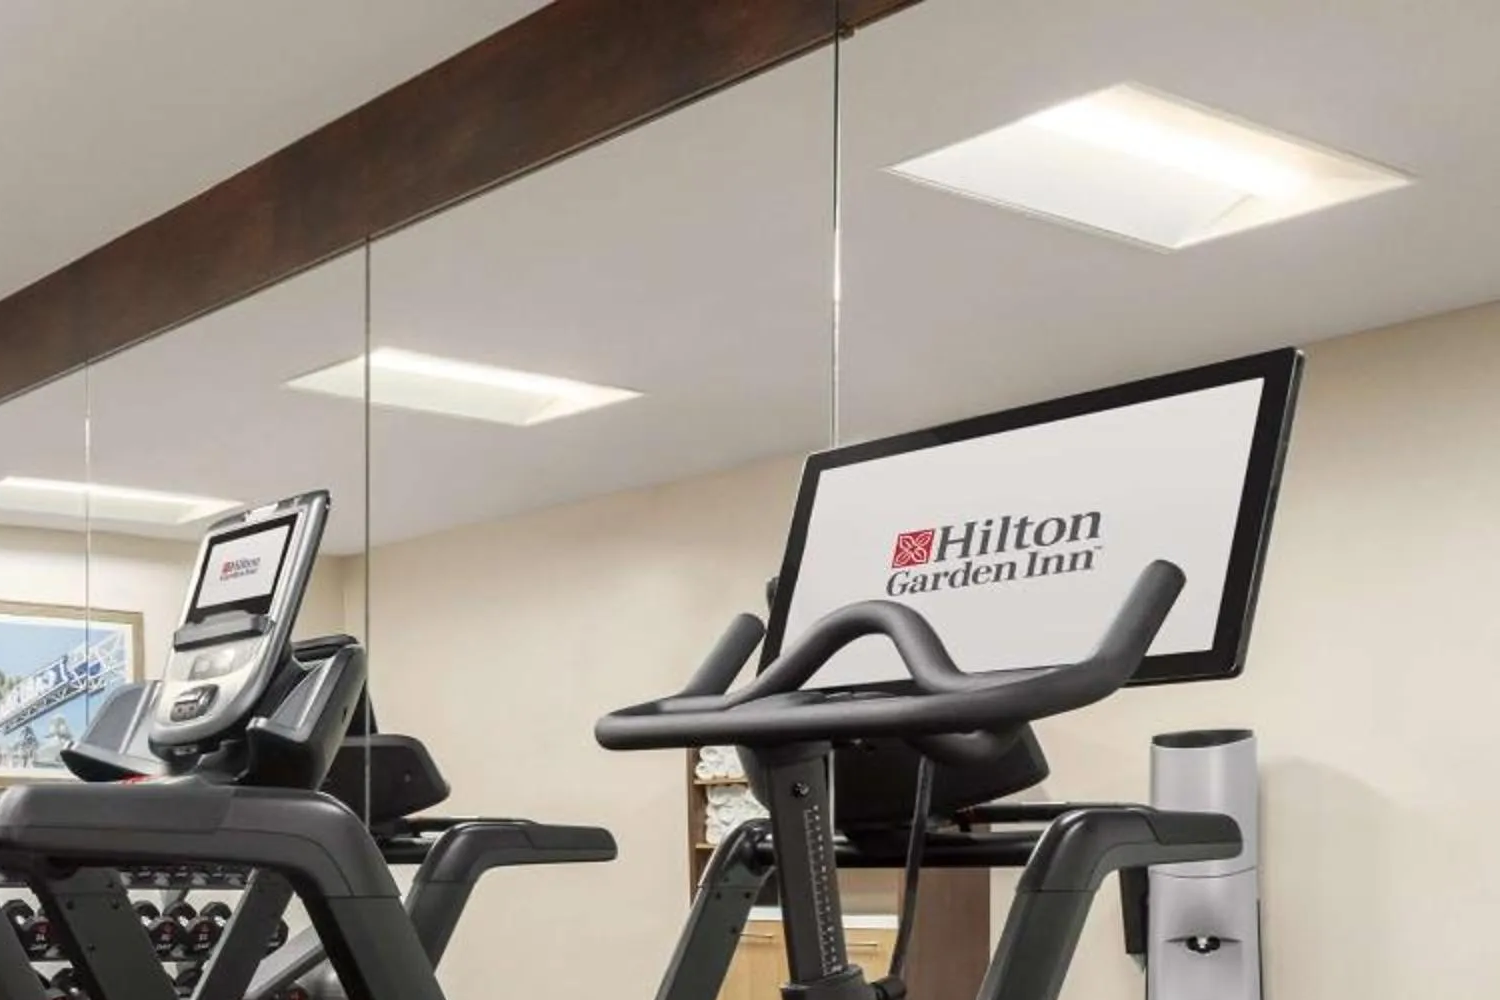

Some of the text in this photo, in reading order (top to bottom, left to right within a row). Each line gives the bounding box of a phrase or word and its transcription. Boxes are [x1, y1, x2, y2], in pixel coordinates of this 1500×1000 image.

[934, 510, 1101, 562] Hilton
[885, 548, 1095, 597] Garden Inn
